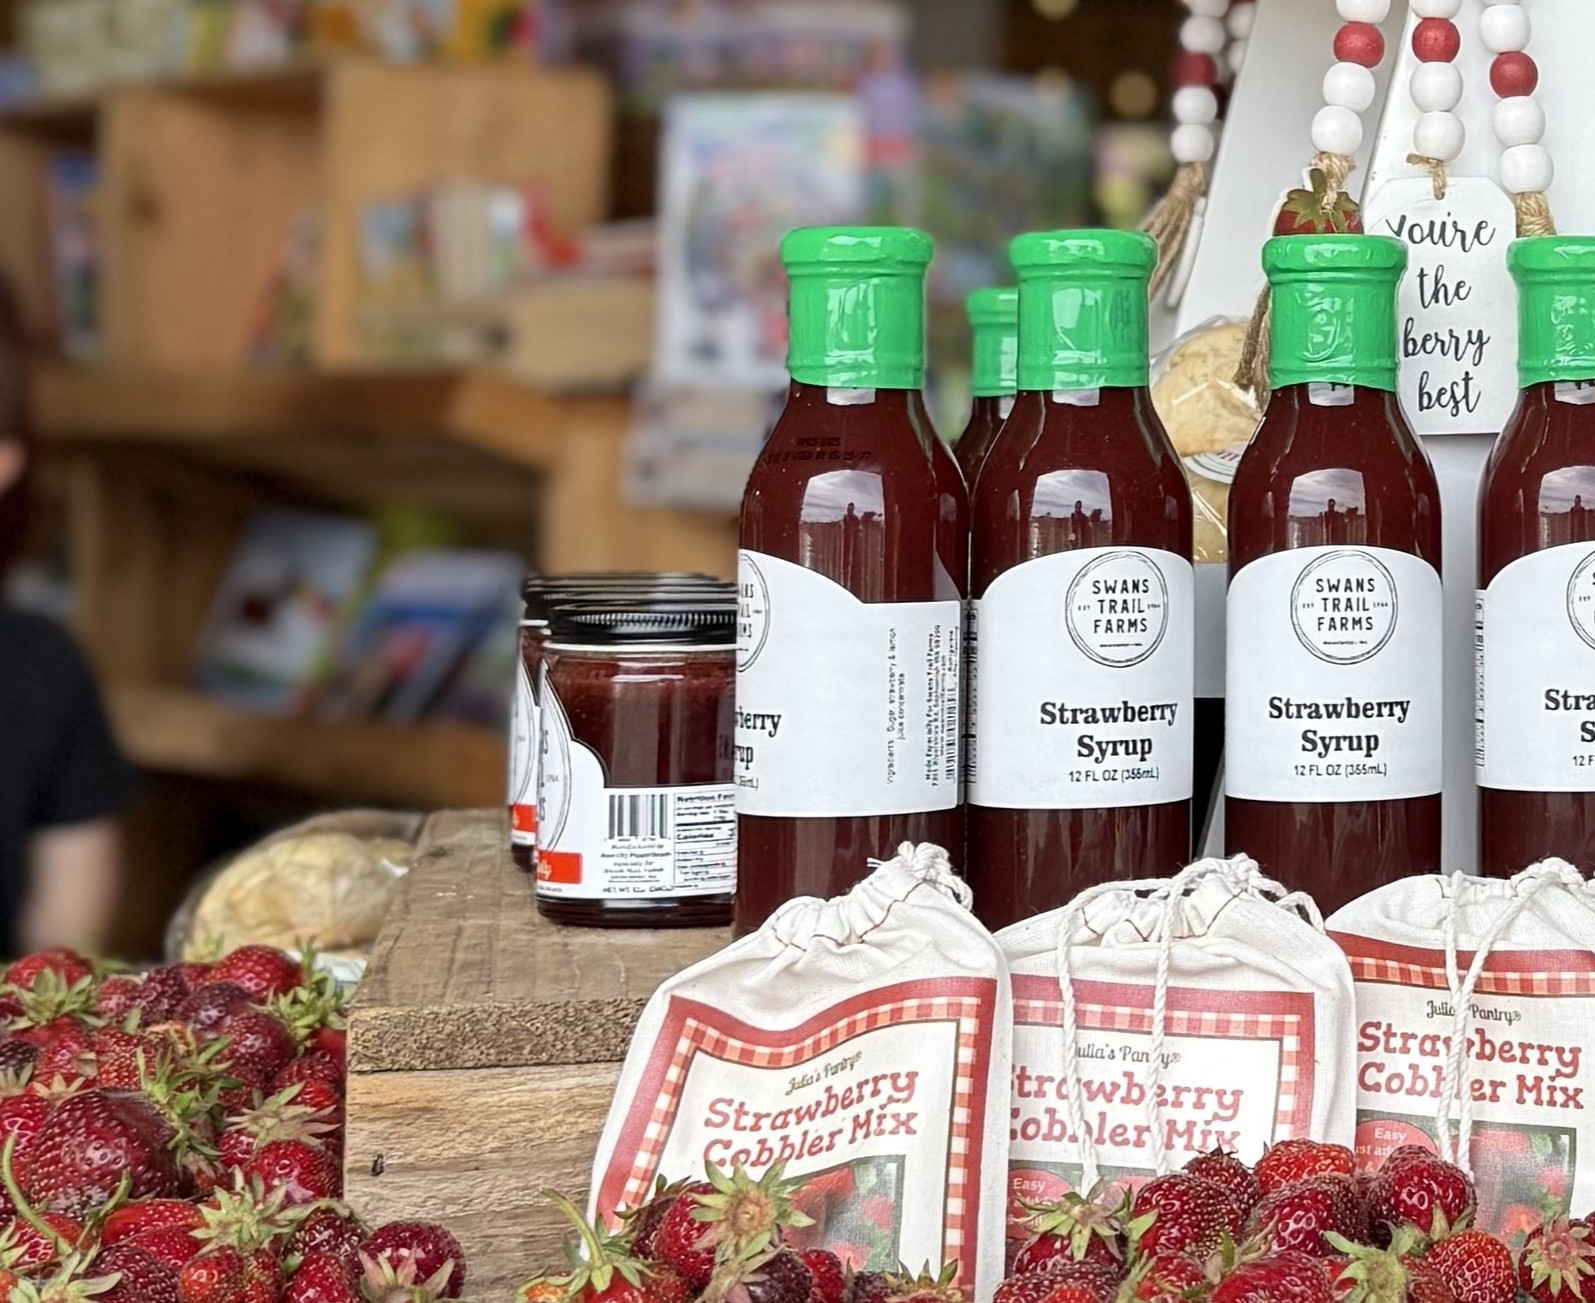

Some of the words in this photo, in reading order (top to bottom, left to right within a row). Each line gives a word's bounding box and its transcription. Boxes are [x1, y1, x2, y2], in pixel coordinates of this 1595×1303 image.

[1417, 264, 1472, 309] the
[1403, 317, 1491, 367] berry
[1418, 370, 1482, 417] best
[1092, 579, 1149, 594] SWANS
[1316, 578, 1375, 593] SWANS
[1097, 598, 1145, 614] TRAIL
[1321, 597, 1370, 612] TRAIL
[1094, 618, 1147, 634] FARMS
[1318, 616, 1373, 631] FARMS
[1040, 701, 1178, 726] Strawberry
[1269, 696, 1410, 723] Strawberry
[1077, 735, 1153, 764] Syrup
[1301, 729, 1380, 758] Syrup
[1572, 755, 1585, 766] 12
[1069, 770, 1082, 782] 12
[1085, 770, 1098, 781] FL
[1103, 769, 1118, 781] OZ
[1294, 765, 1306, 776] 12
[1309, 765, 1322, 776] FL
[1326, 765, 1342, 776] OZ
[1075, 1043, 1116, 1061] ulia's
[1516, 1074, 1584, 1110] Mix
[703, 1070, 919, 1133] Strawberry
[703, 1126, 844, 1169] Cobbler
[848, 1102, 919, 1144] Mix
[1164, 1119, 1241, 1152] Mix
[1374, 1127, 1407, 1144] Easy
[1013, 1177, 1046, 1194] Easy
